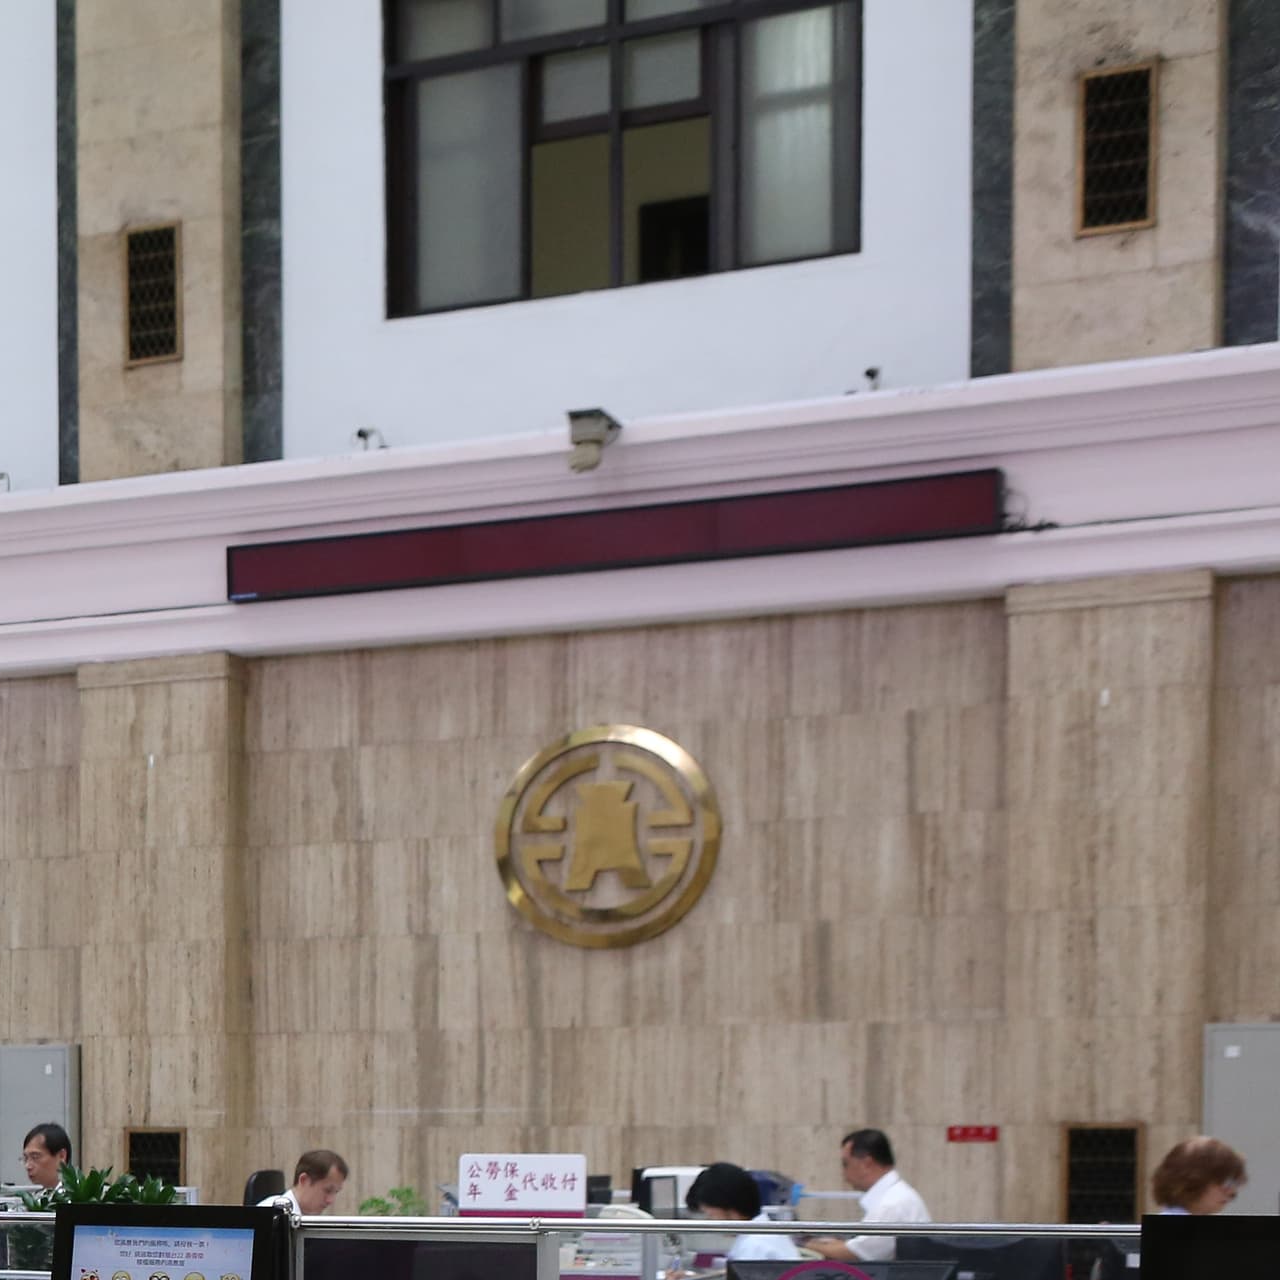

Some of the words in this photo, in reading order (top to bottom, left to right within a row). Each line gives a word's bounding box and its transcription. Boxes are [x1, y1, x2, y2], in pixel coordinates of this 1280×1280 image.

[467, 1161, 519, 1180] 公勞保
[522, 1172, 578, 1192] 代收付
